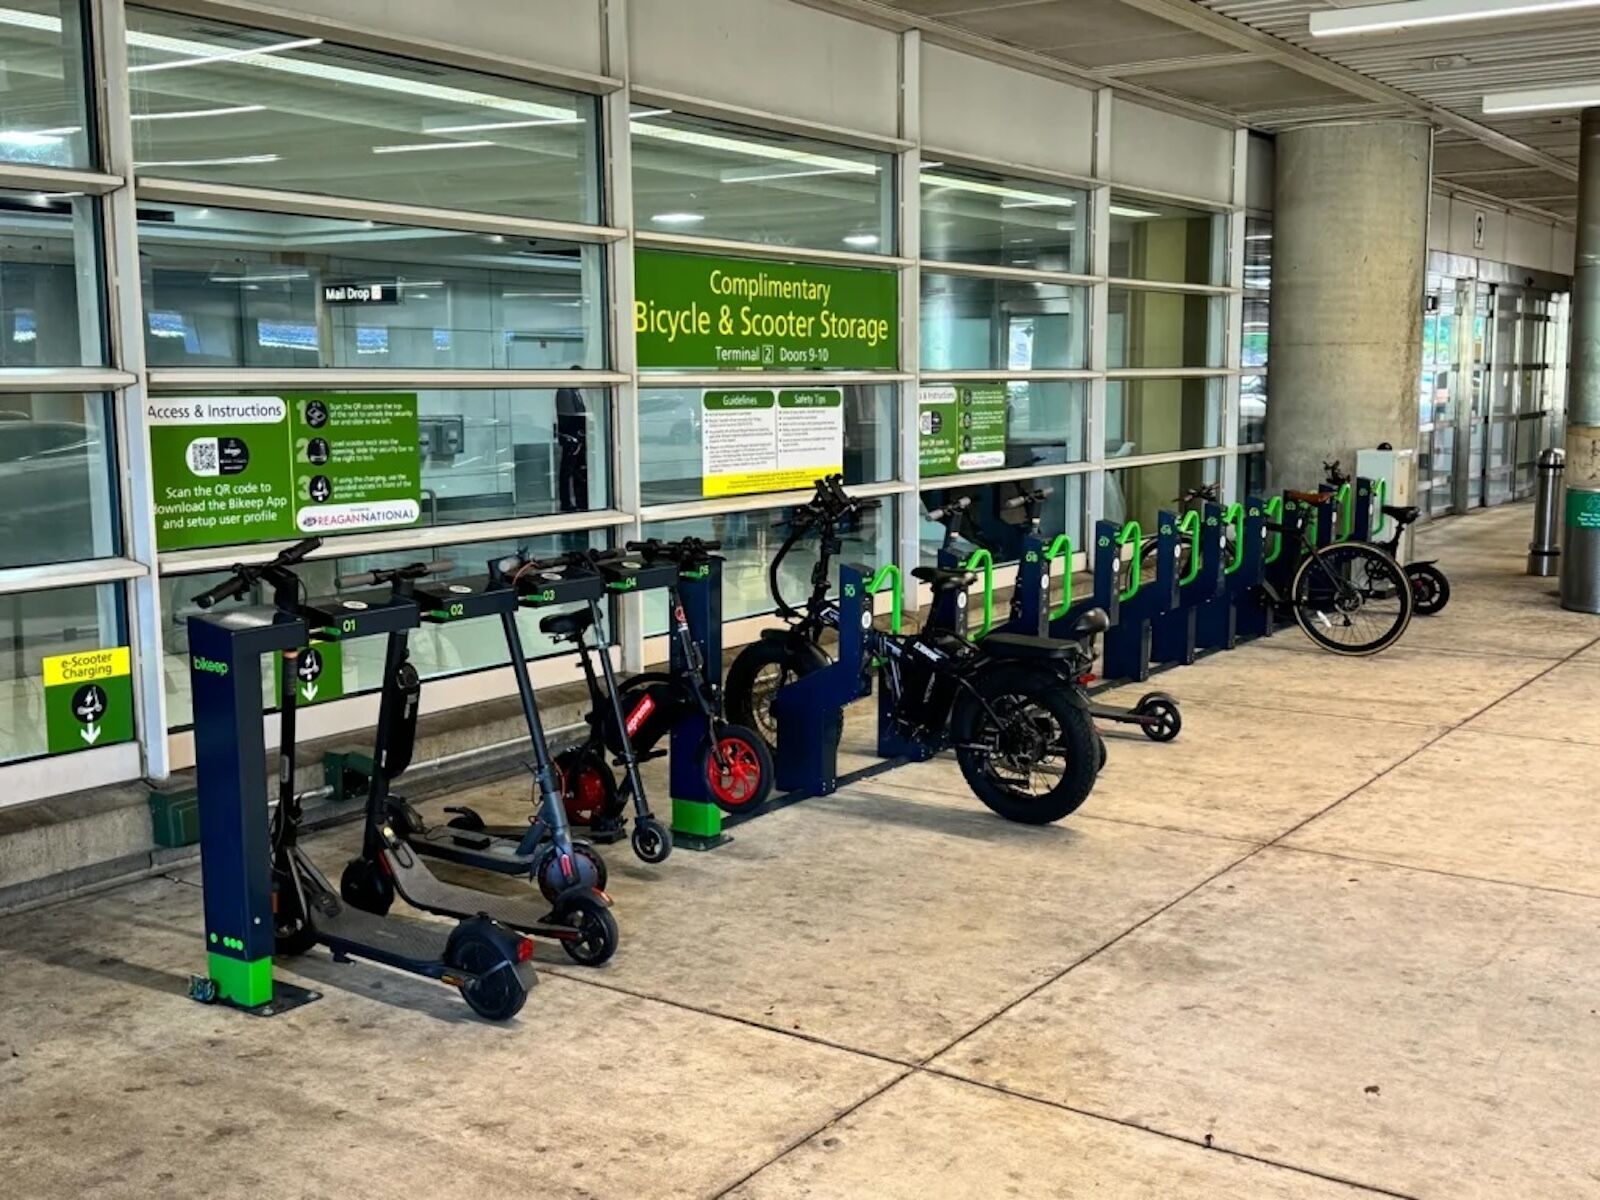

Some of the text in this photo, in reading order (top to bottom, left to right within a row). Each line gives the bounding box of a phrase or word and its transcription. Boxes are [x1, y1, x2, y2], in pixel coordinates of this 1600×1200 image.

[326, 287, 370, 301] Mail Drop
[709, 269, 831, 305] Complimentary
[634, 301, 889, 347] Bicycle & Scooter Storage
[715, 346, 829, 363] Terminal 2 Doors 9-10
[723, 395, 758, 406] Guidelines
[794, 394, 813, 405] Safety
[148, 403, 282, 418] Access & Instructions
[165, 483, 272, 499] Scan the QR code to
[208, 499, 226, 510] the
[228, 497, 264, 510] Bikeep
[266, 496, 287, 508] App
[163, 510, 277, 529] and setup user profile
[626, 577, 637, 588] 04
[542, 590, 555, 601] 03
[450, 604, 463, 616] 02
[343, 619, 355, 632] 01
[61, 653, 112, 669] e-Scooter
[193, 656, 228, 676] bikeep
[62, 665, 112, 680] Charging
